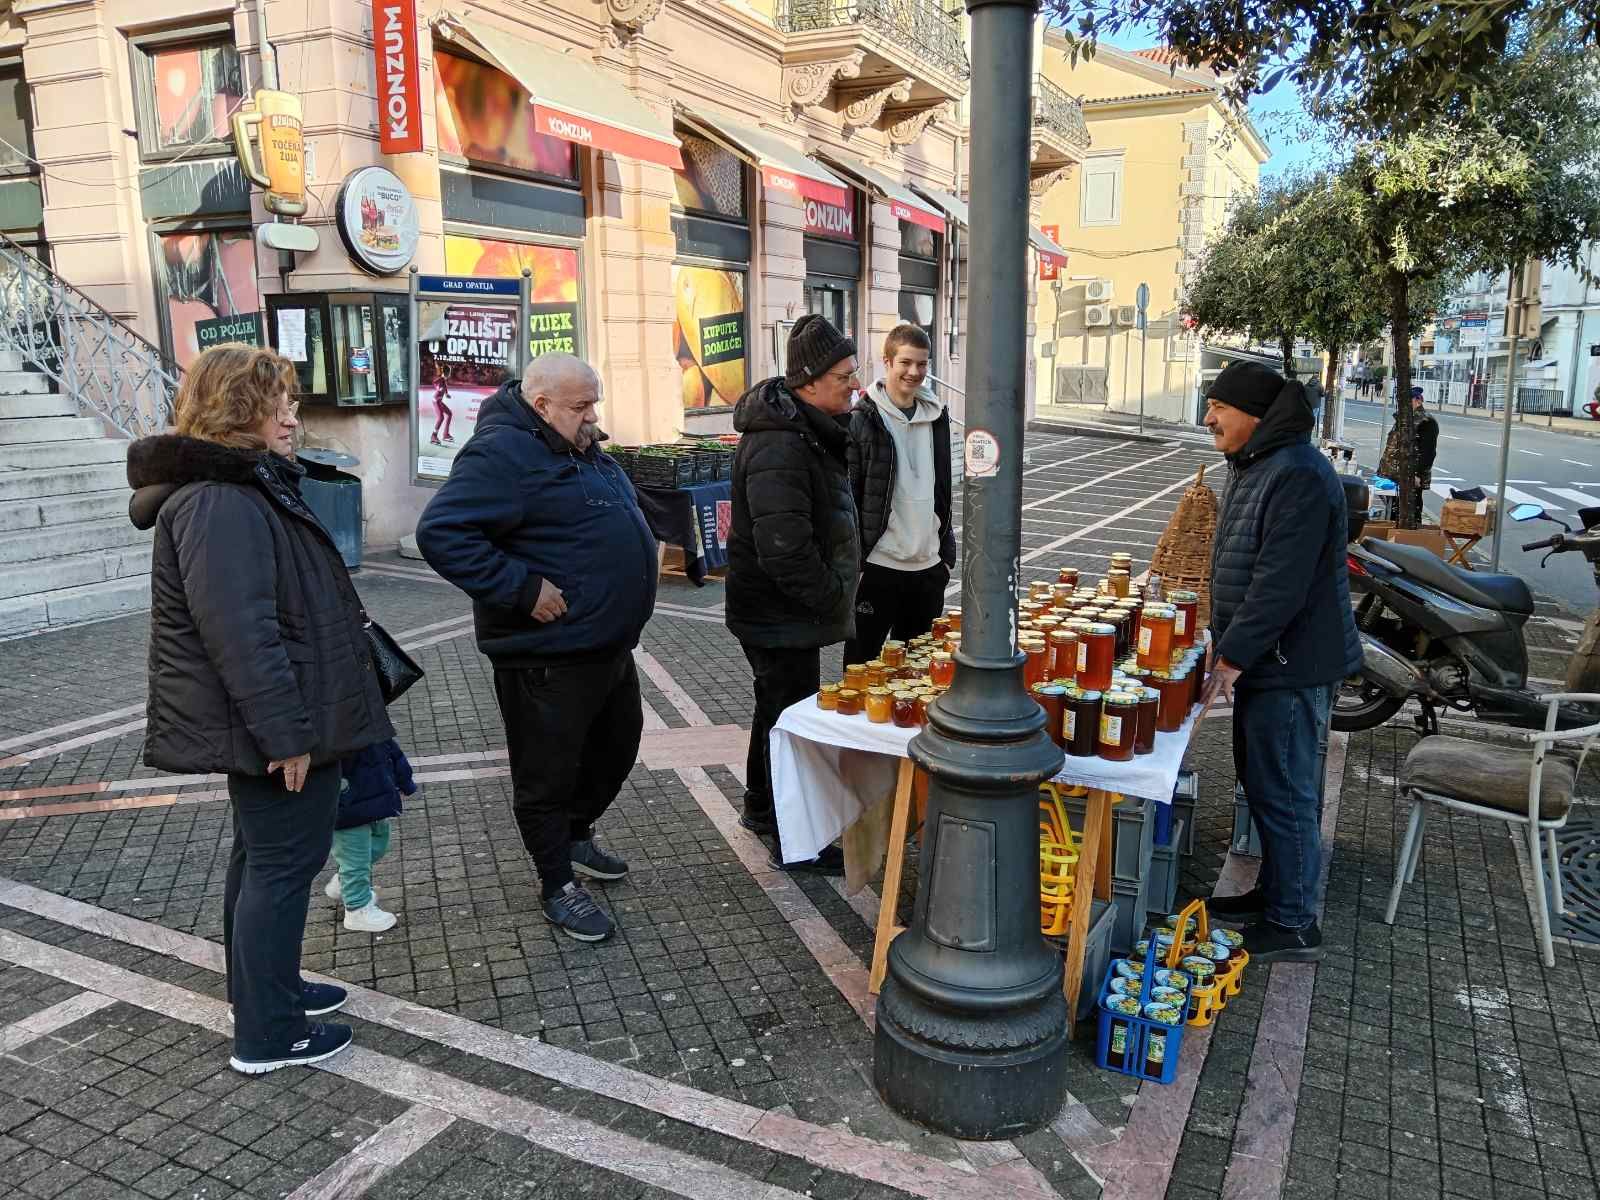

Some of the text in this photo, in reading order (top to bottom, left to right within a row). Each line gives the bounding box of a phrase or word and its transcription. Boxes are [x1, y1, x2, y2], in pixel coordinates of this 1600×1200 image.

[384, 6, 408, 139] KONZUM
[548, 117, 592, 142] KONZUM
[443, 280, 494, 290] GRAD OPATIJA
[530, 312, 574, 333] VIJEK
[703, 321, 738, 339] KUPUJTE
[200, 327, 218, 340] OD
[446, 337, 508, 358] OPATIJI
